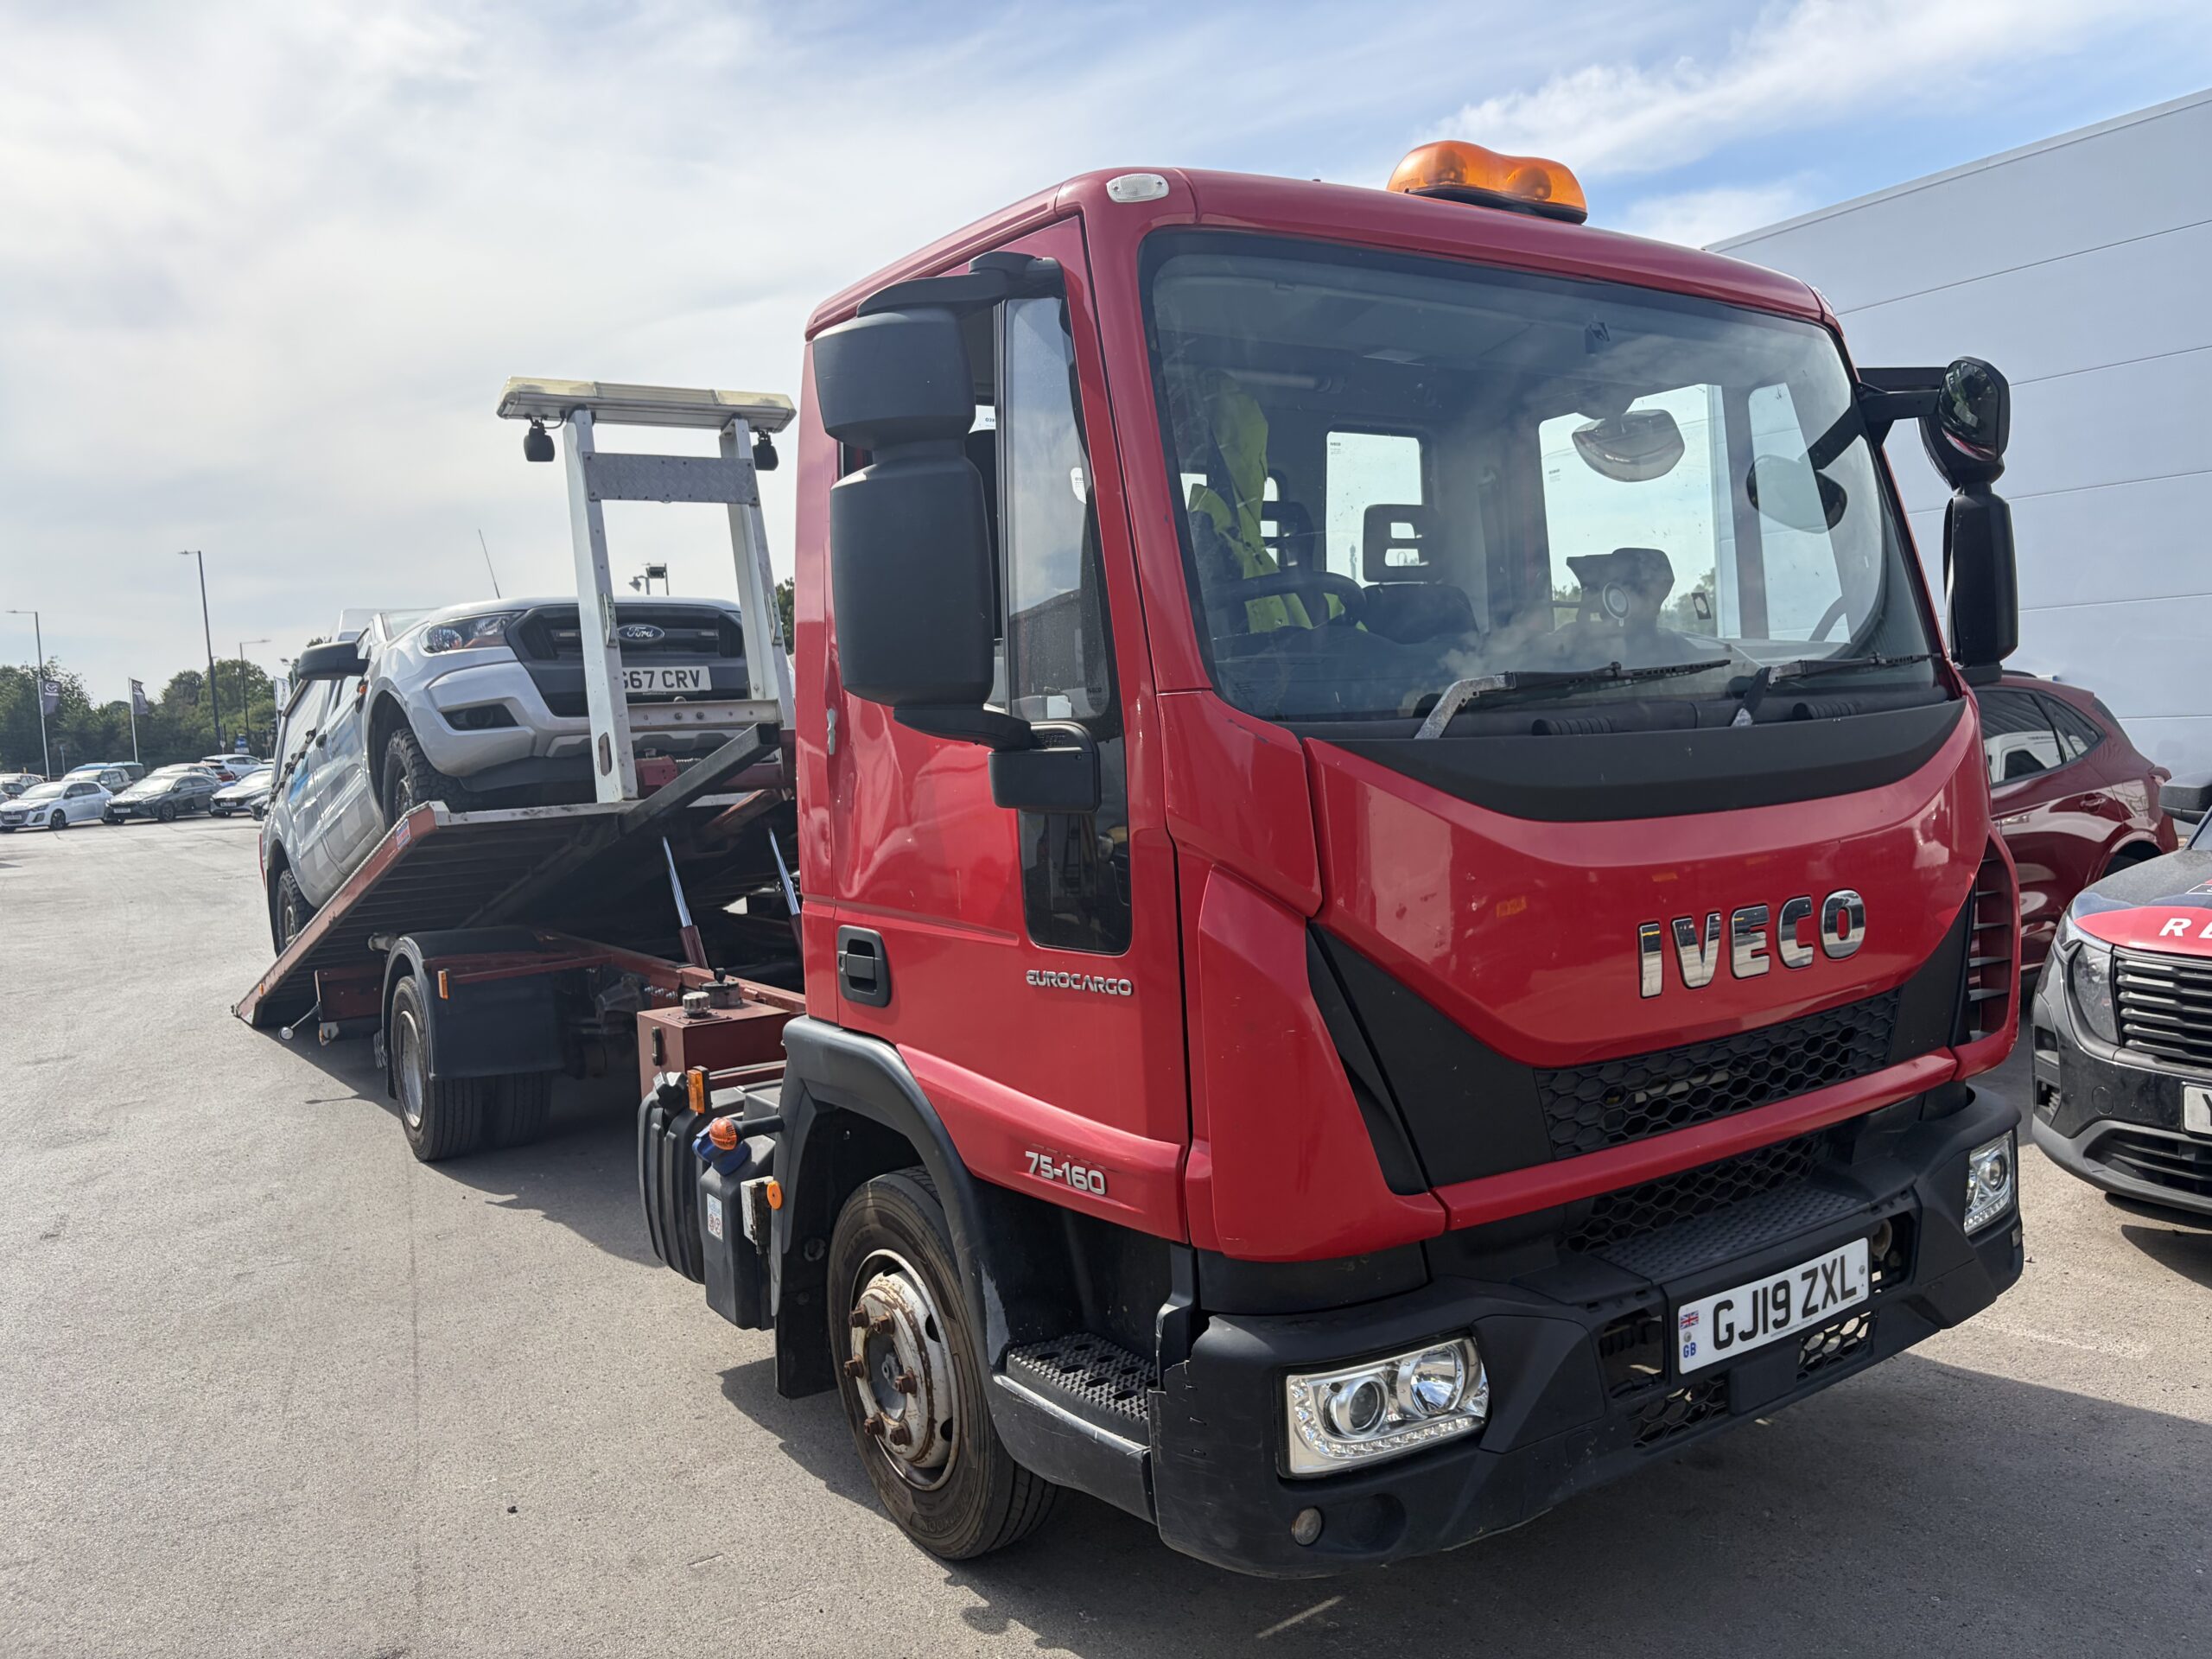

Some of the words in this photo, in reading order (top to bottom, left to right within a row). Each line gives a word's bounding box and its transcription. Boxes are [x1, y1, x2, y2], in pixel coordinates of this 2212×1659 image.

[626, 626, 654, 638] Ford
[661, 670, 700, 689] CRV
[1639, 889, 1866, 998] IVECO
[1026, 969, 1133, 996] EUROCARGO
[1025, 1150, 1106, 1195] 75-160
[1713, 1279, 1790, 1351] GJ19
[1801, 1255, 1858, 1319] ZXL
[1682, 1342, 1697, 1358] GB
